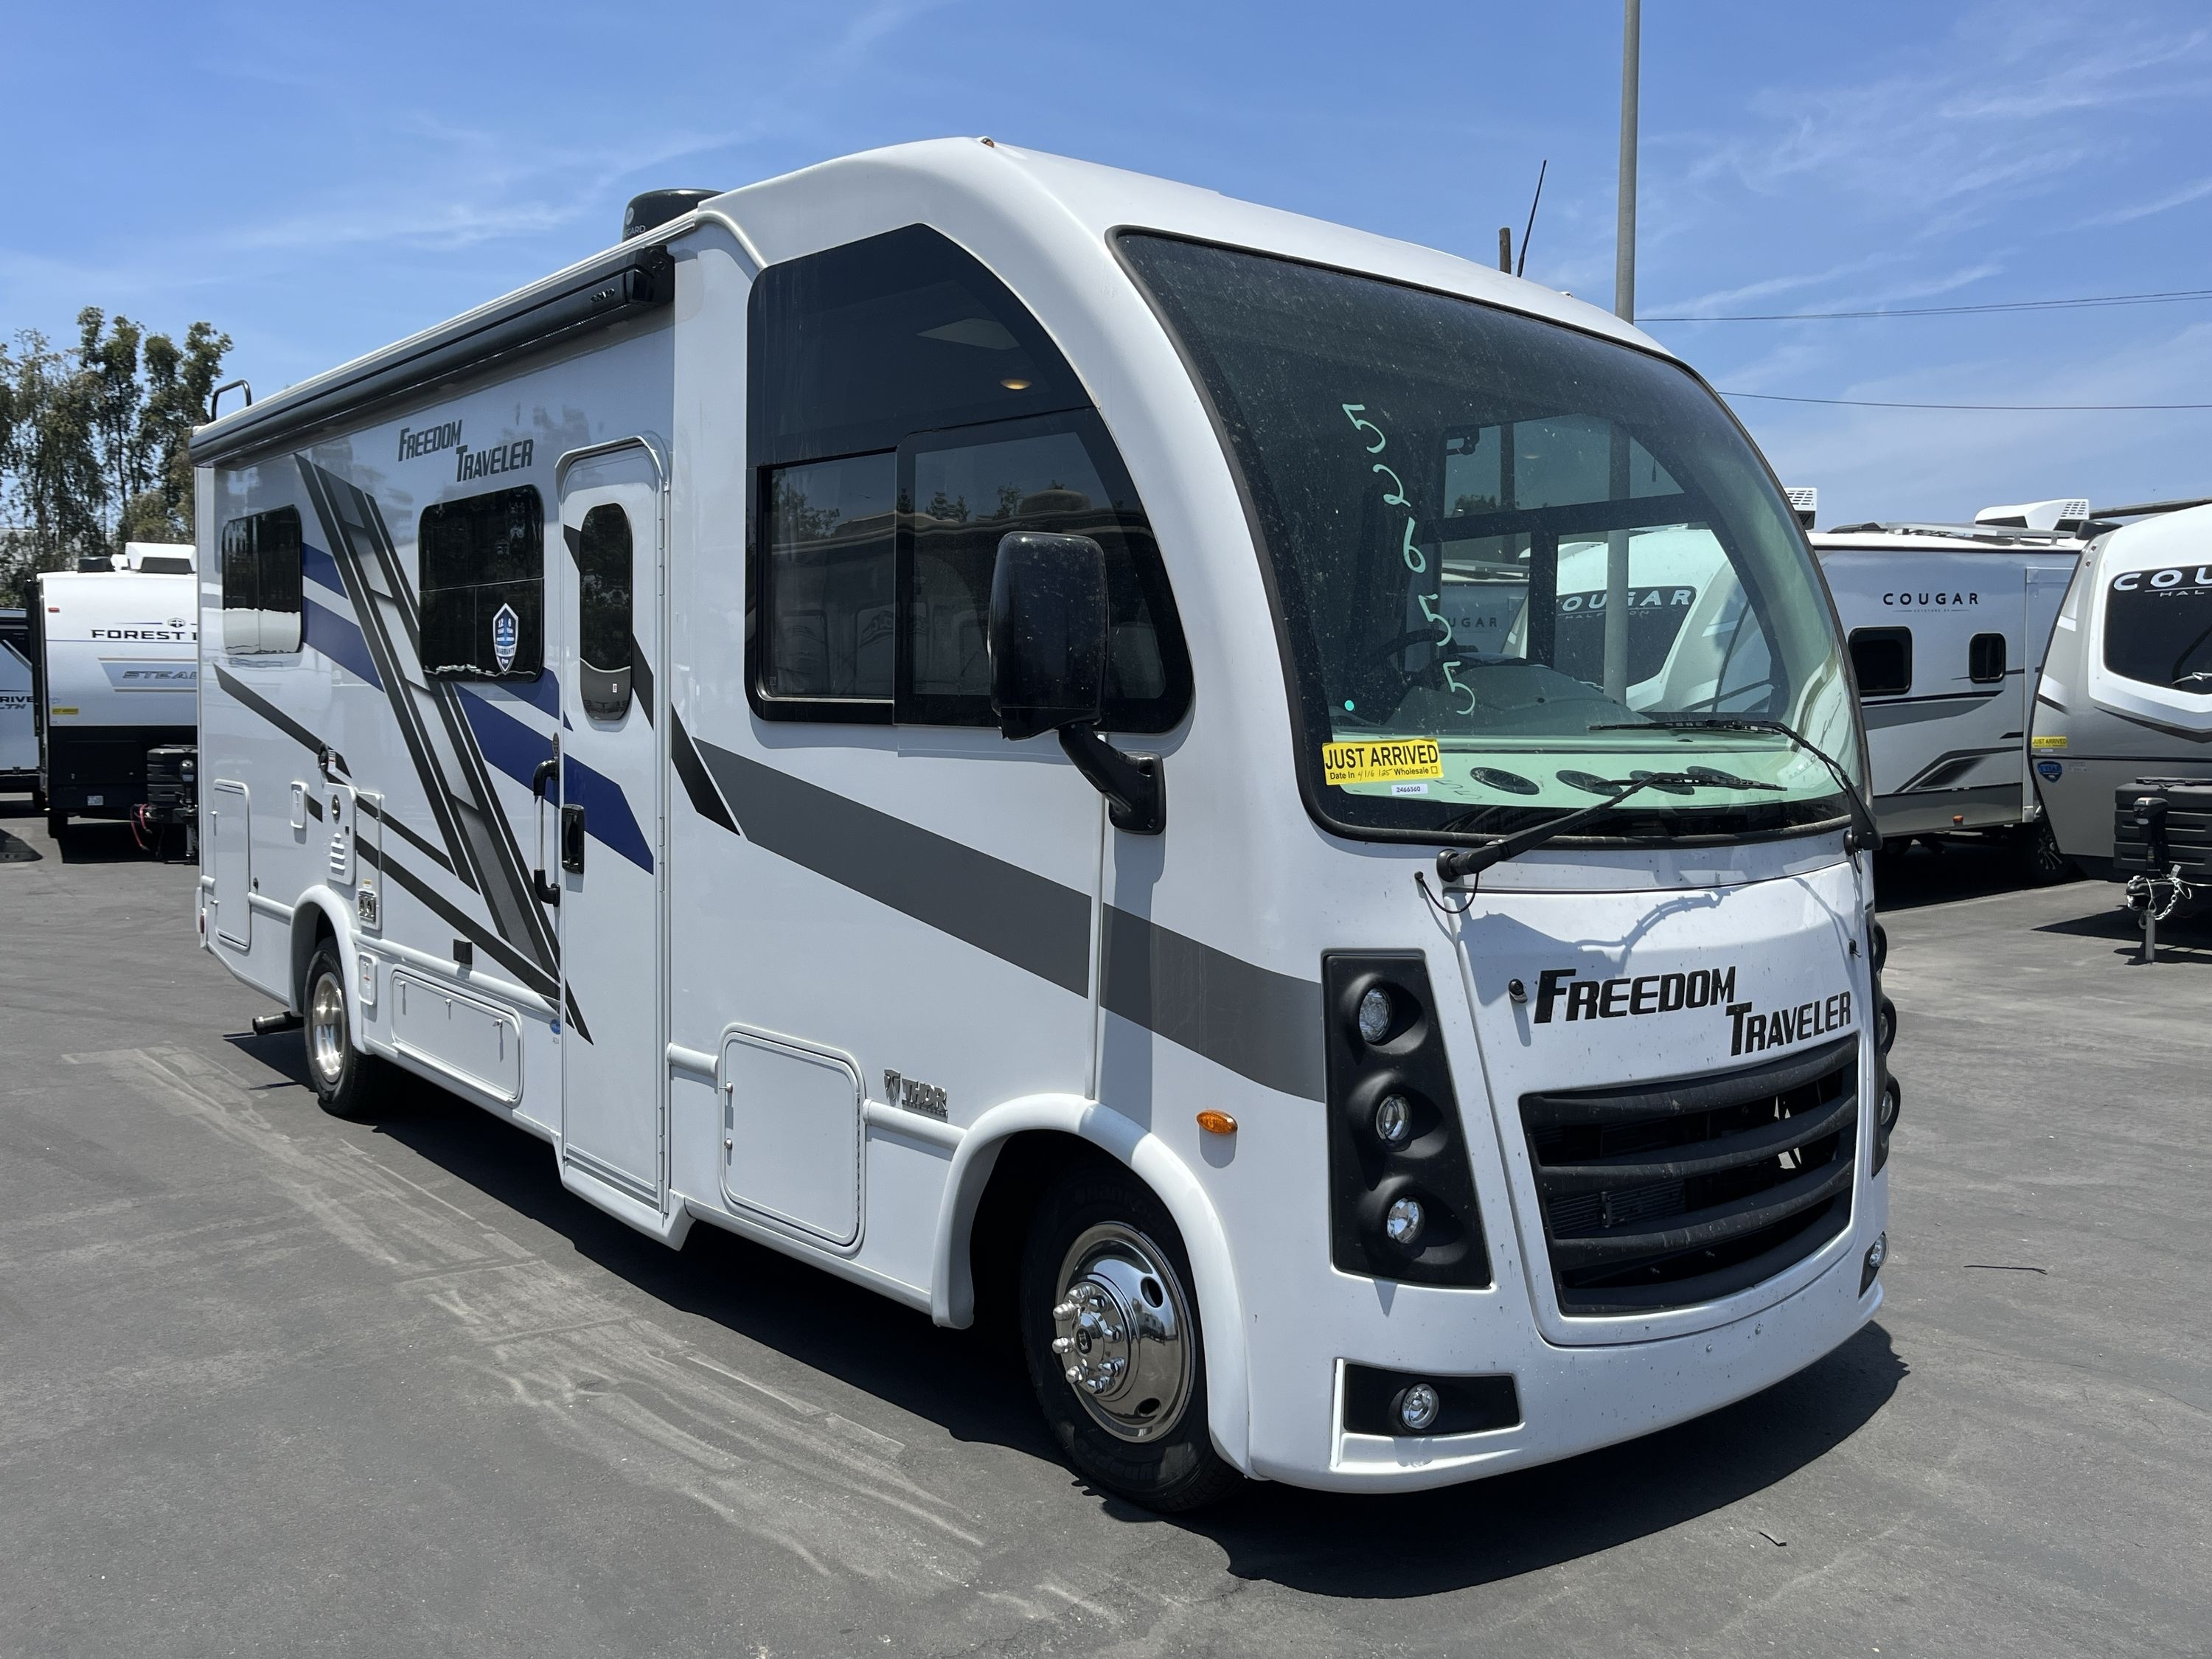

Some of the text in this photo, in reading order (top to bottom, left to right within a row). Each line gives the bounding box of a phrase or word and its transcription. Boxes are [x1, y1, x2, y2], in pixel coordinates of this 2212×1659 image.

[397, 420, 462, 462] FREEDOM
[456, 439, 534, 482] TRAVELER
[1883, 593, 1978, 605] COUGAR
[90, 630, 186, 641] FOREST
[1325, 745, 1439, 770] JUST ARRIVED
[1330, 771, 1346, 780] Date
[1348, 771, 1355, 779] In
[1394, 766, 1429, 776] Wholesale
[1533, 966, 1736, 1024] FREEDOM
[1725, 990, 1851, 1057] TRAVELER
